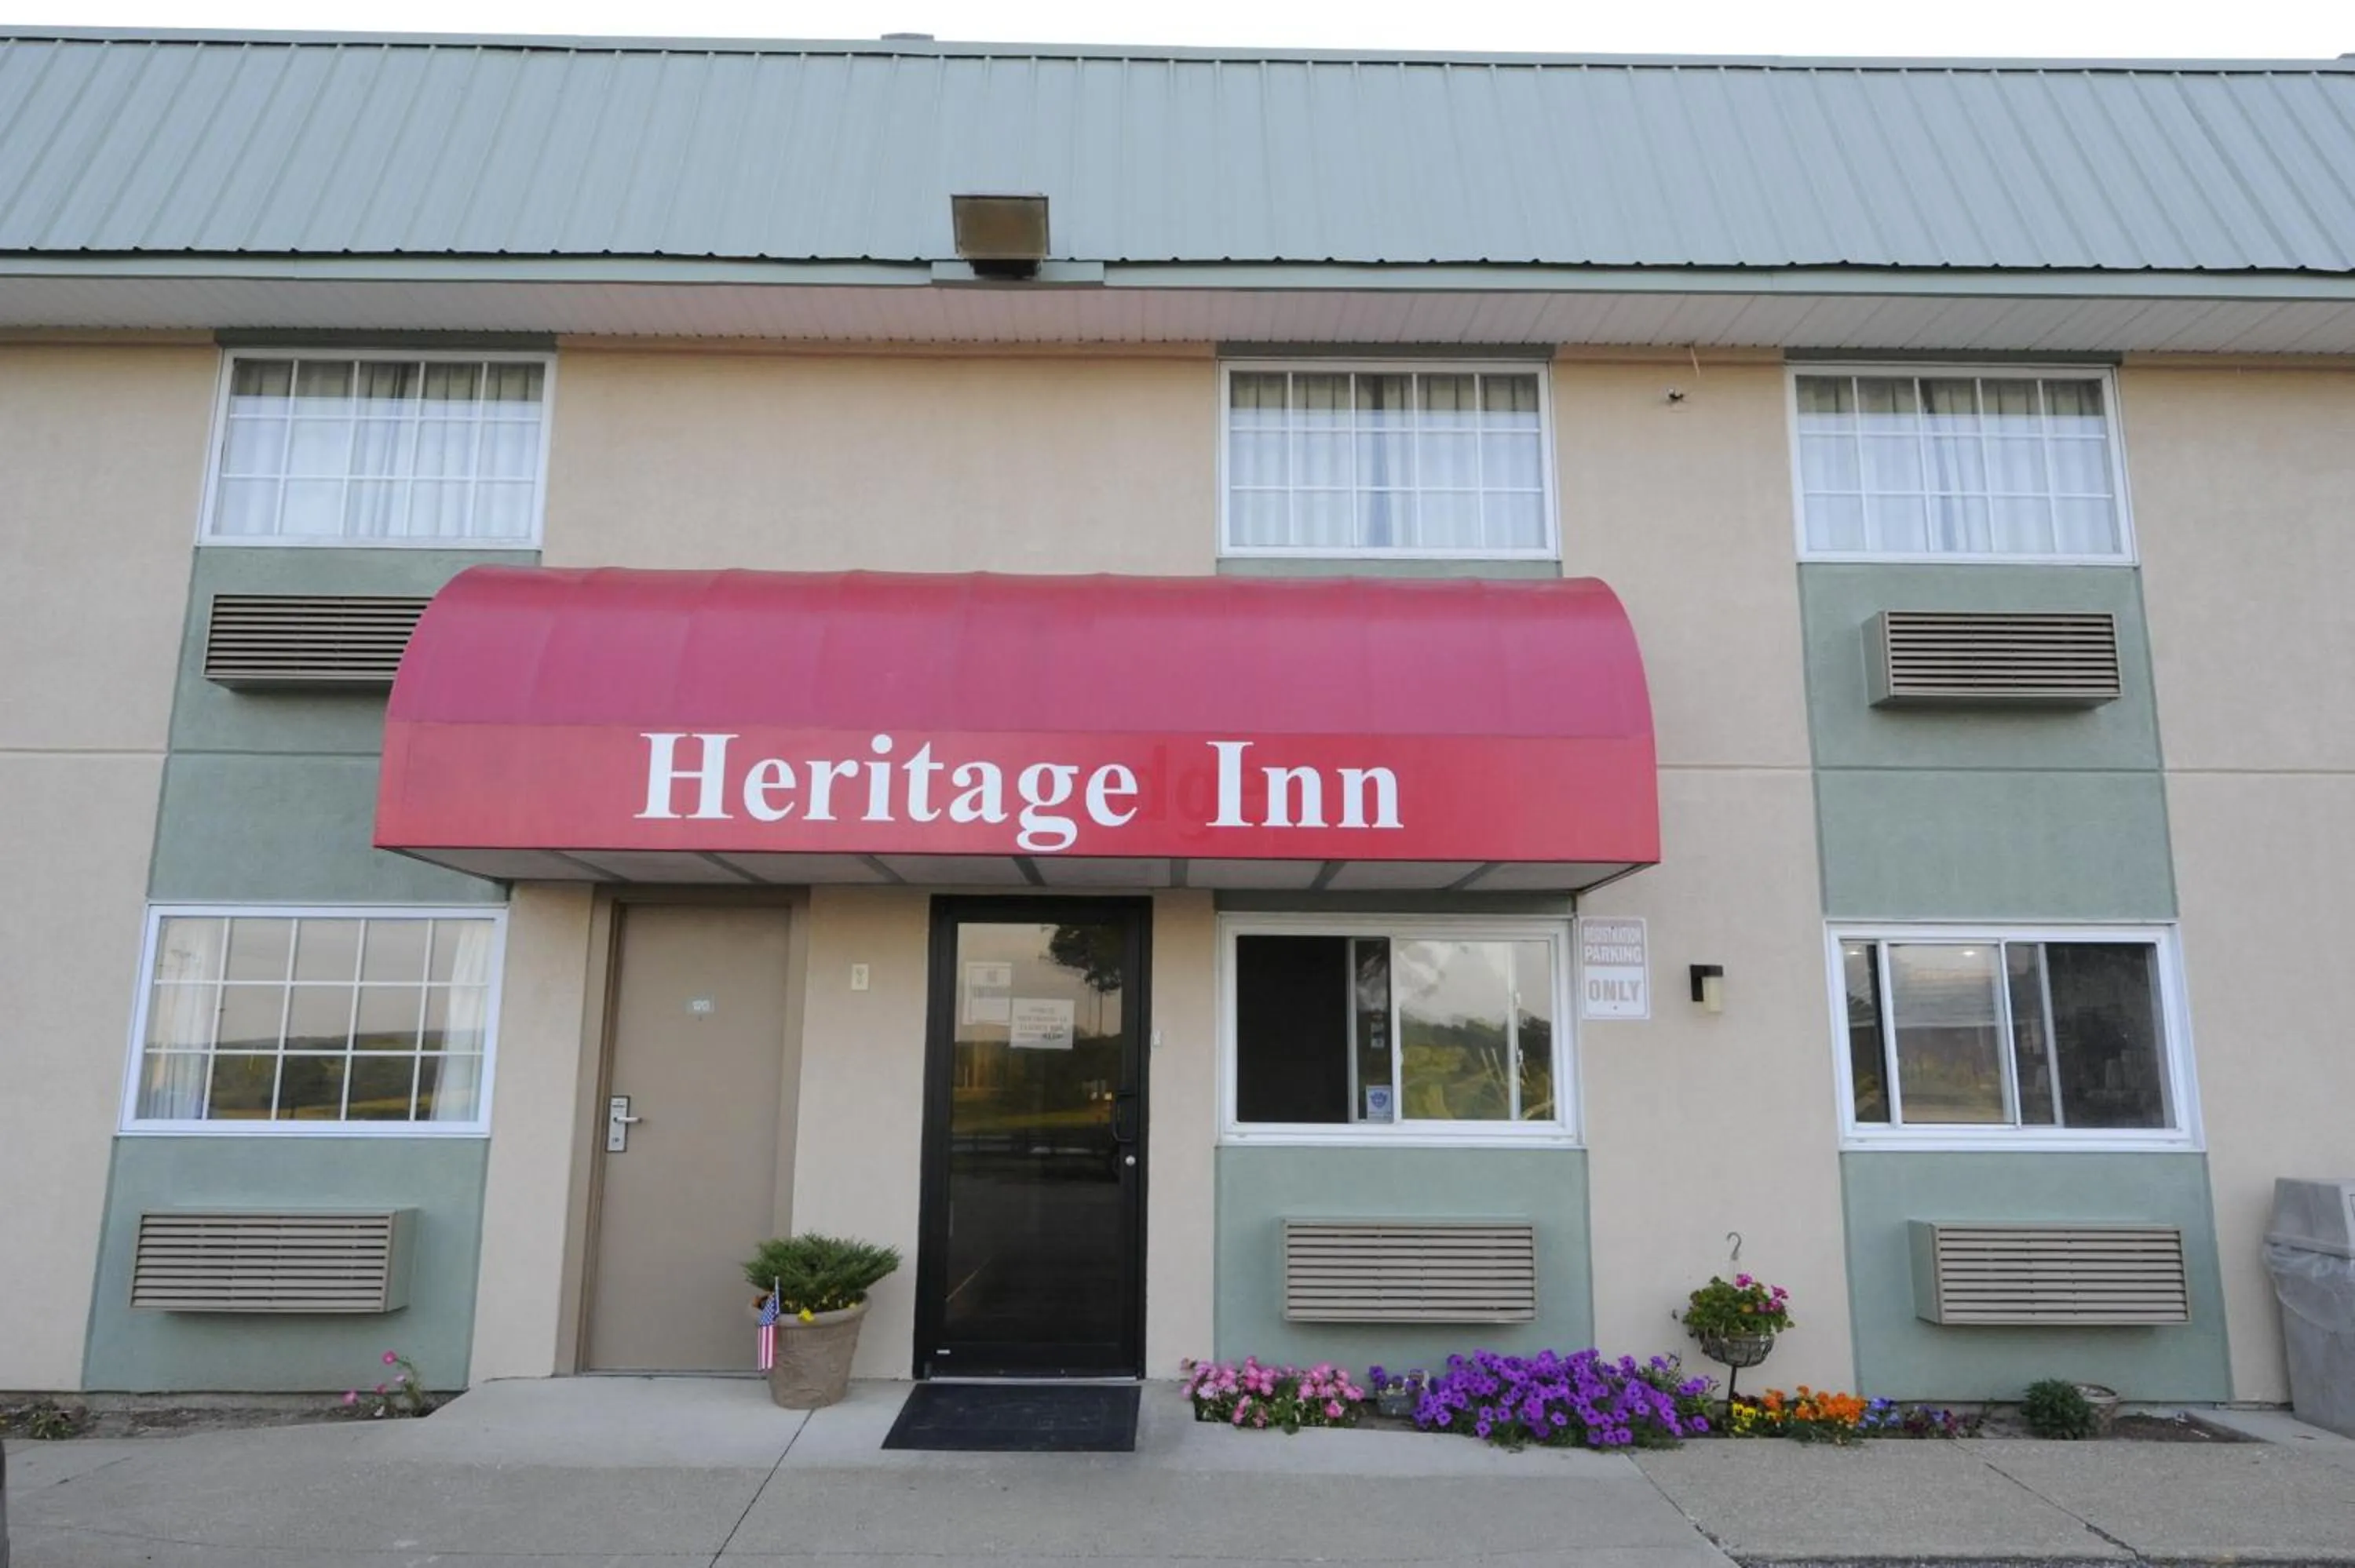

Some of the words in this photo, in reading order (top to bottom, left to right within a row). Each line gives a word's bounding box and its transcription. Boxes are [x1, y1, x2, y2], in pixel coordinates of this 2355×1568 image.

[633, 731, 1138, 852] Heritage
[1205, 739, 1405, 830] Inn
[1584, 945, 1643, 963] PARKING
[1588, 979, 1641, 1002] ONLY
